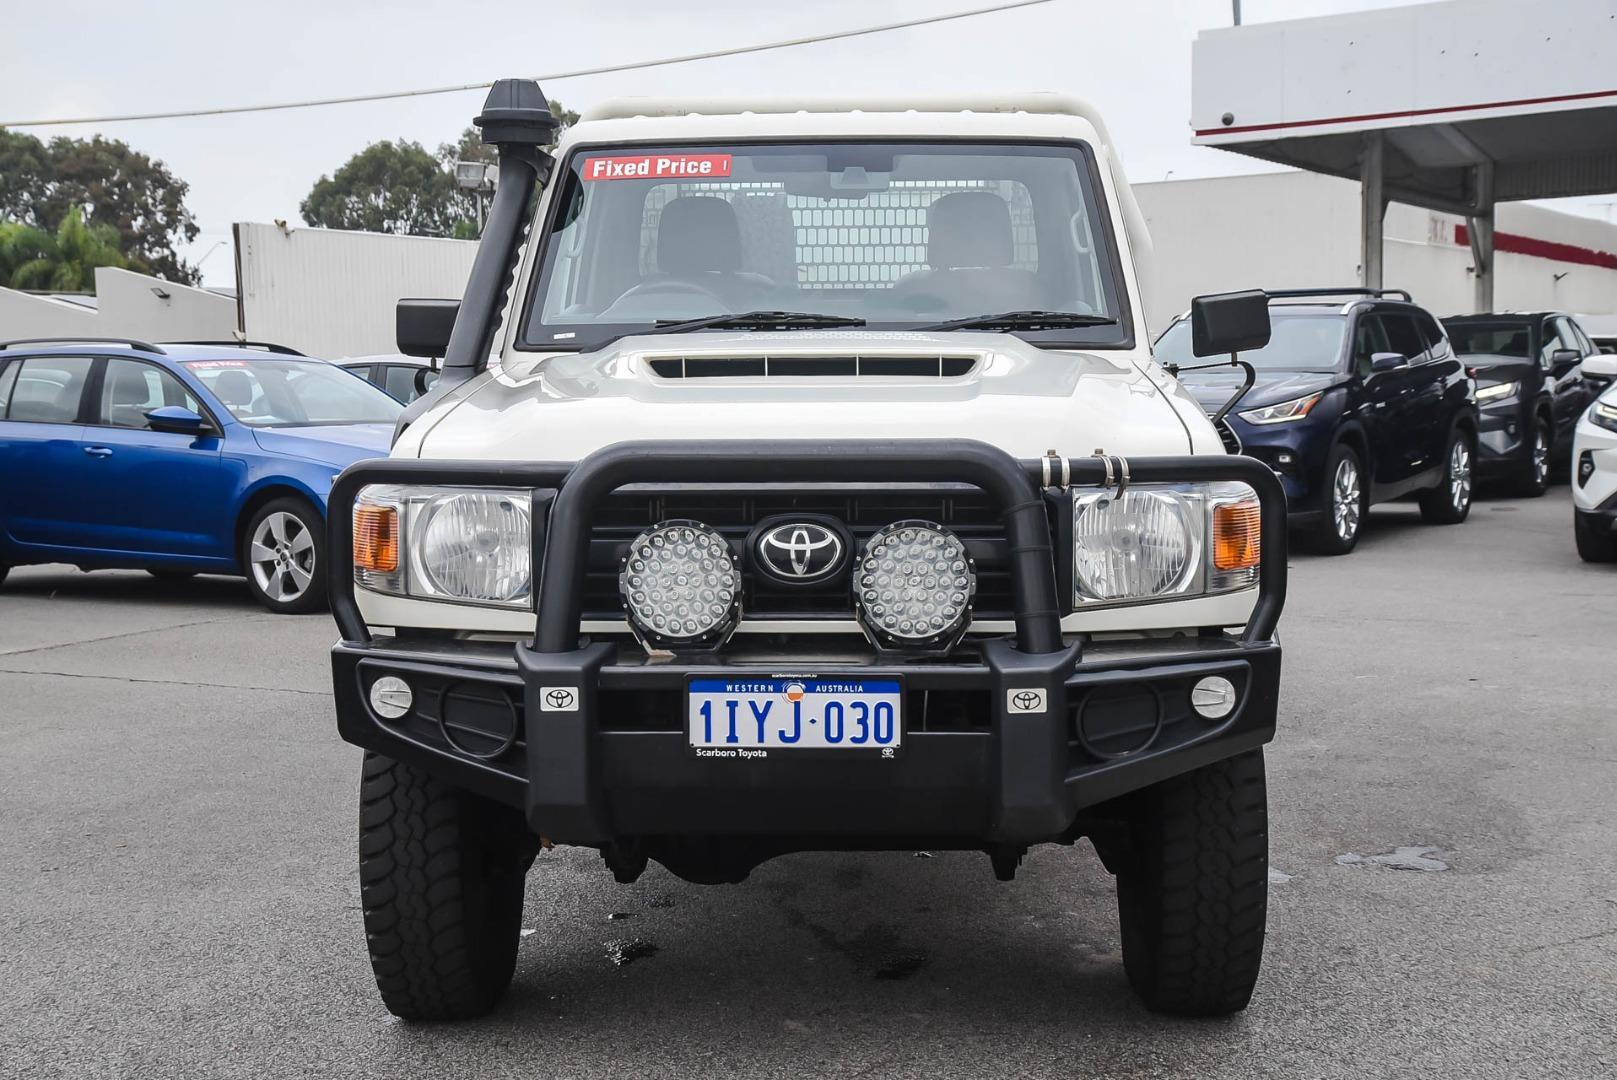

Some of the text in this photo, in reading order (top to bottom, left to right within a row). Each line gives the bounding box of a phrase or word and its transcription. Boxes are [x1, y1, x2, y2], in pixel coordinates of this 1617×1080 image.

[592, 158, 712, 177] Fixed Price
[726, 684, 864, 693] WESTERN AUSTRALIA
[696, 748, 767, 759] Scarboro Toyota
